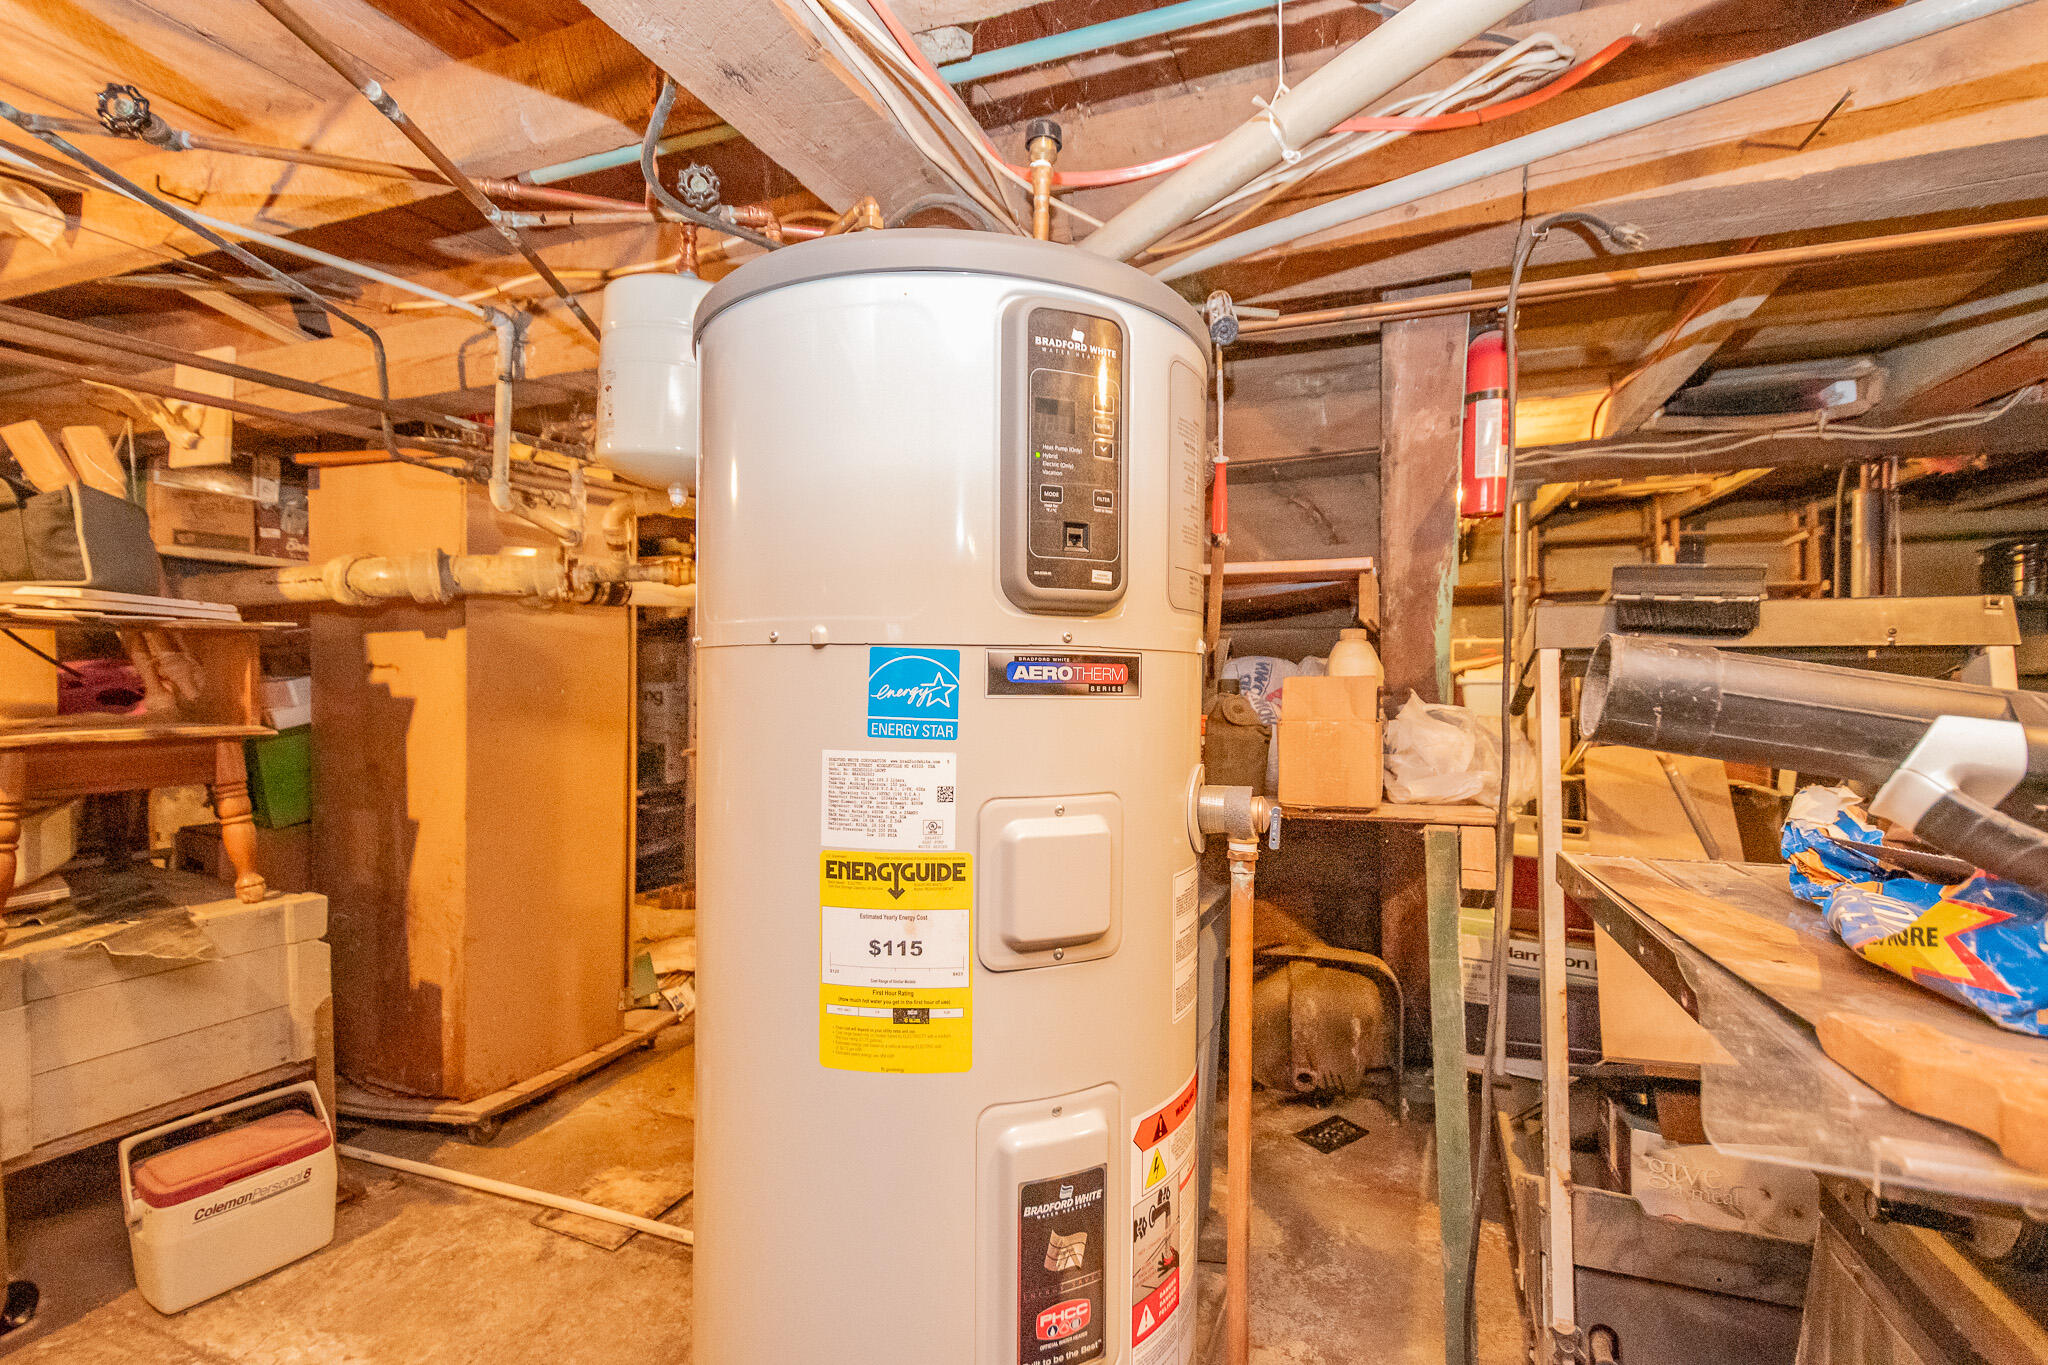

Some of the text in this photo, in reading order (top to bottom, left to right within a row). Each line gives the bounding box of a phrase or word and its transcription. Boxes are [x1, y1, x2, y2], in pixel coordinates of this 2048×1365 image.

[1035, 336, 1116, 358] BRADFORD WHITE
[1042, 346, 1070, 356] WATER
[1042, 452, 1058, 460] Hybrid
[1012, 665, 1124, 682] AEROTHERM
[871, 722, 954, 738] ENERGY STAR
[826, 860, 966, 882] ENERGYGUIDE
[883, 914, 898, 922] Yearly
[898, 914, 916, 922] Energy
[868, 939, 923, 958] $115
[1648, 1155, 1723, 1189] give
[194, 1168, 312, 1220] Coleman Personal 8
[1024, 1189, 1103, 1217] BRADFORD WHITE
[1040, 1302, 1088, 1328] PHCC
[1053, 1355, 1064, 1364] be
[1066, 1350, 1079, 1360] the
